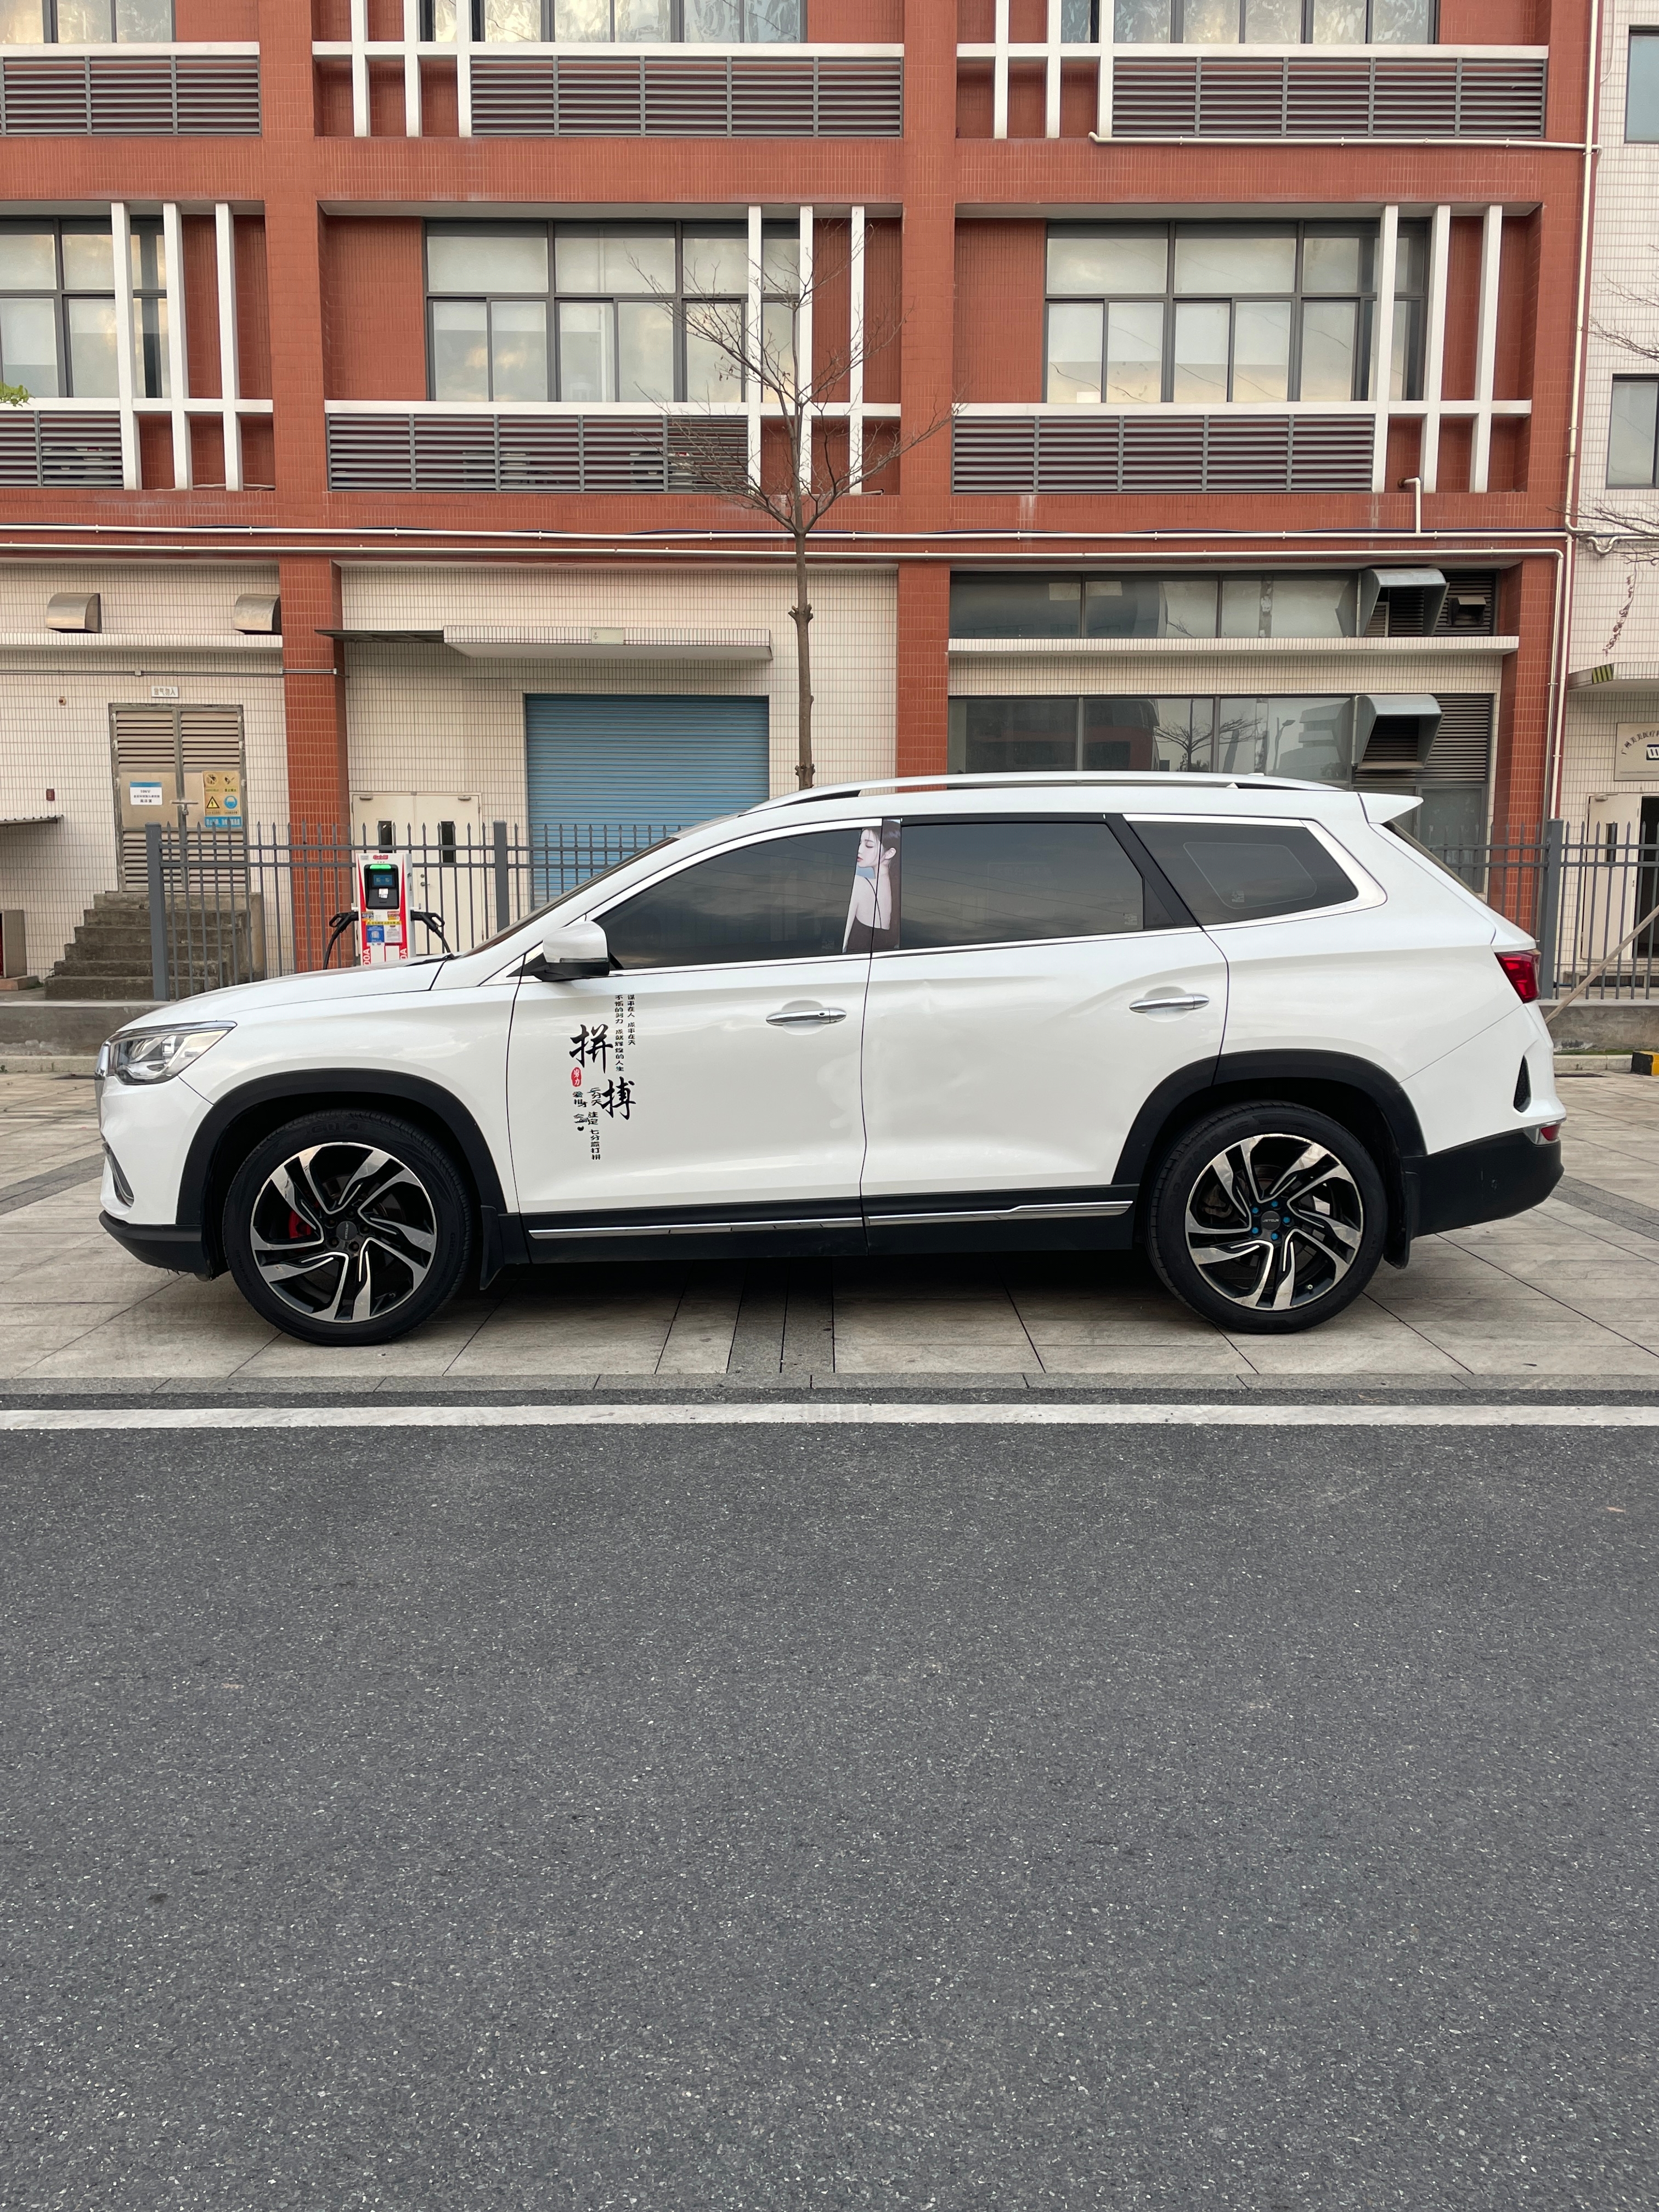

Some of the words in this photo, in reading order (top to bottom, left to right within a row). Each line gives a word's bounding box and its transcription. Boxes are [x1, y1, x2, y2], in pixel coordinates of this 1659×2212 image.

[1621, 730, 1659, 755] 广州美美医疗
